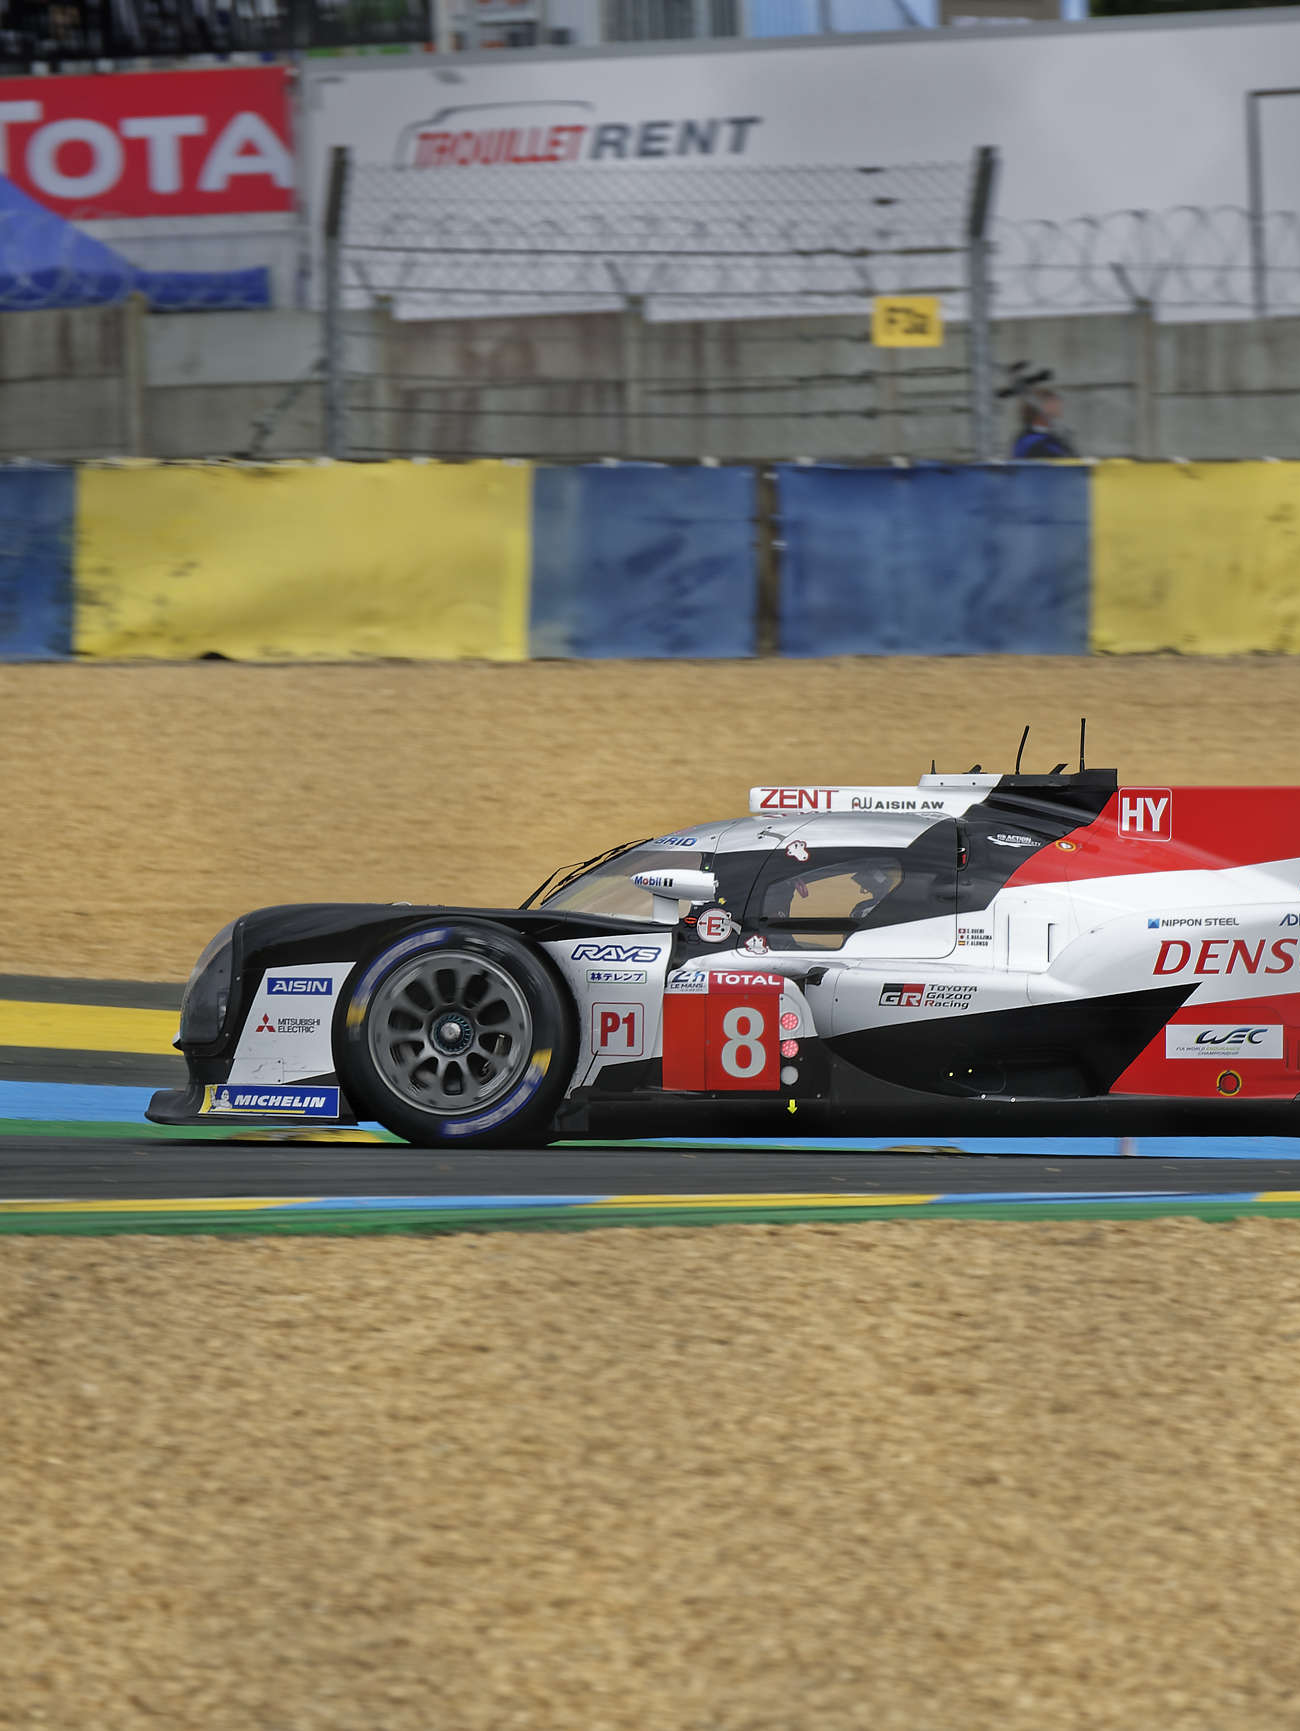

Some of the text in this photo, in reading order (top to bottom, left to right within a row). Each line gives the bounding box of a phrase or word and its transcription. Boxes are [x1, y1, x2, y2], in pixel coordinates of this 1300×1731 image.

[414, 115, 764, 169] TROUILLET RENT
[759, 788, 840, 809] ZENT
[875, 801, 916, 810] AISIN
[921, 801, 945, 810] AW
[1121, 797, 1169, 832] HY
[634, 876, 662, 887] Mobil
[1161, 918, 1240, 927] NIPPON STEEL
[571, 944, 662, 962] RAYS
[712, 972, 781, 986] TOTAL
[272, 980, 329, 993] AISIN
[928, 983, 978, 992] TOYOTA
[880, 991, 922, 1007] GR
[926, 992, 972, 1000] GAZOO
[924, 1000, 970, 1010] Racing
[277, 1018, 321, 1026] MITSUBISHI
[277, 1025, 316, 1033] ELECTRIC
[600, 1011, 636, 1048] P1
[1195, 1027, 1269, 1044] WEC
[721, 1006, 767, 1078] 8
[233, 1094, 327, 1108] MICHELIN
